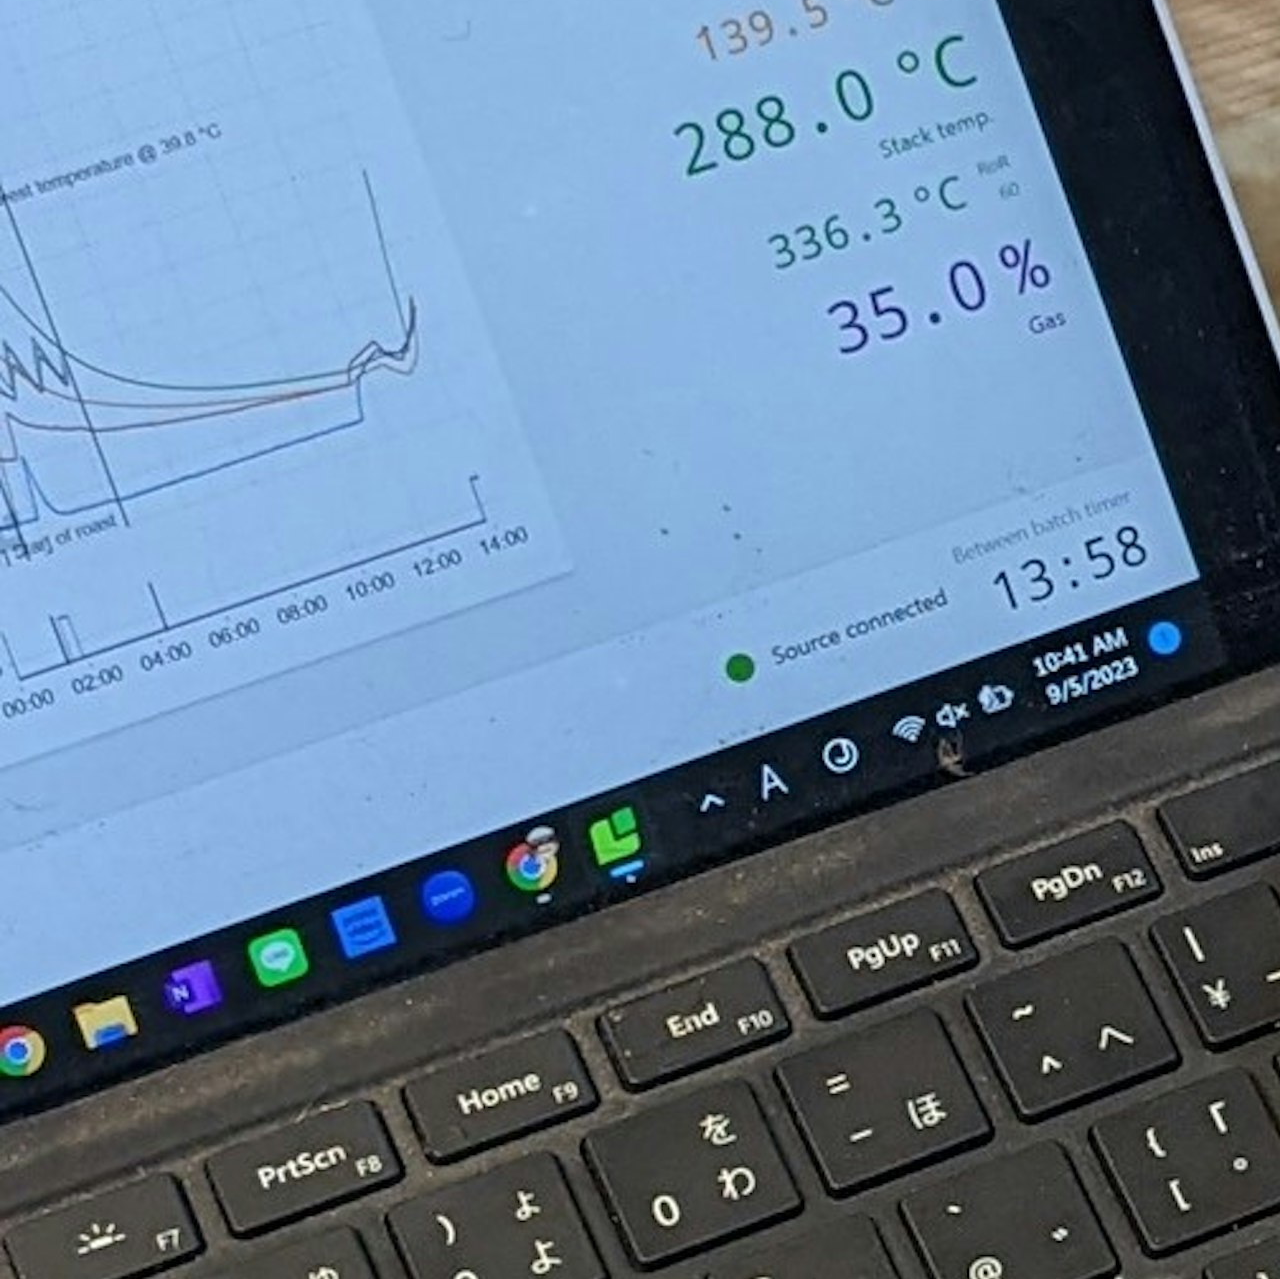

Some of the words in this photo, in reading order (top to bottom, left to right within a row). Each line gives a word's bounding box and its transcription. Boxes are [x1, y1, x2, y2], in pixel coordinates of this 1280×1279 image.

[878, 129, 933, 159] Stack
[36, 153, 135, 191] temperature
[137, 144, 157, 164] @
[1028, 310, 1066, 335] Gas
[55, 528, 72, 545] of
[952, 530, 1024, 564] Between
[1029, 508, 1080, 539] batch
[1085, 491, 1131, 520] timer
[993, 525, 1149, 610] 13:58
[3, 689, 54, 719] 00:00
[71, 666, 123, 696] 02:00
[140, 641, 192, 672] 04:00
[209, 618, 260, 648] 06:00
[277, 595, 327, 625] 08:00
[345, 571, 395, 601] 10:00
[413, 548, 462, 579] 12:00
[479, 526, 529, 557] 14:00
[772, 631, 840, 666] Source
[846, 588, 948, 637] connected
[1034, 647, 1088, 679] 10:41
[1093, 628, 1129, 664] AM
[1046, 657, 1139, 707] 9/5/2023
[760, 764, 788, 802] A
[1191, 841, 1224, 863] Ins
[1031, 862, 1103, 901] PgDn
[1111, 867, 1148, 895] F12
[847, 929, 921, 971] PgUp
[930, 937, 962, 963] F11
[1203, 978, 1231, 1010] ¥
[665, 1003, 719, 1039] End
[737, 1009, 774, 1036] F10
[458, 1070, 541, 1114] Home
[550, 1079, 579, 1105] F9
[700, 1113, 738, 1147] を
[907, 1091, 948, 1132] ほ
[257, 1143, 348, 1191] PrtScn
[354, 1154, 384, 1178] F8
[718, 1166, 756, 1201] わ
[651, 1194, 681, 1227] 0
[155, 1228, 182, 1253] F7
[530, 1238, 562, 1276] よ
